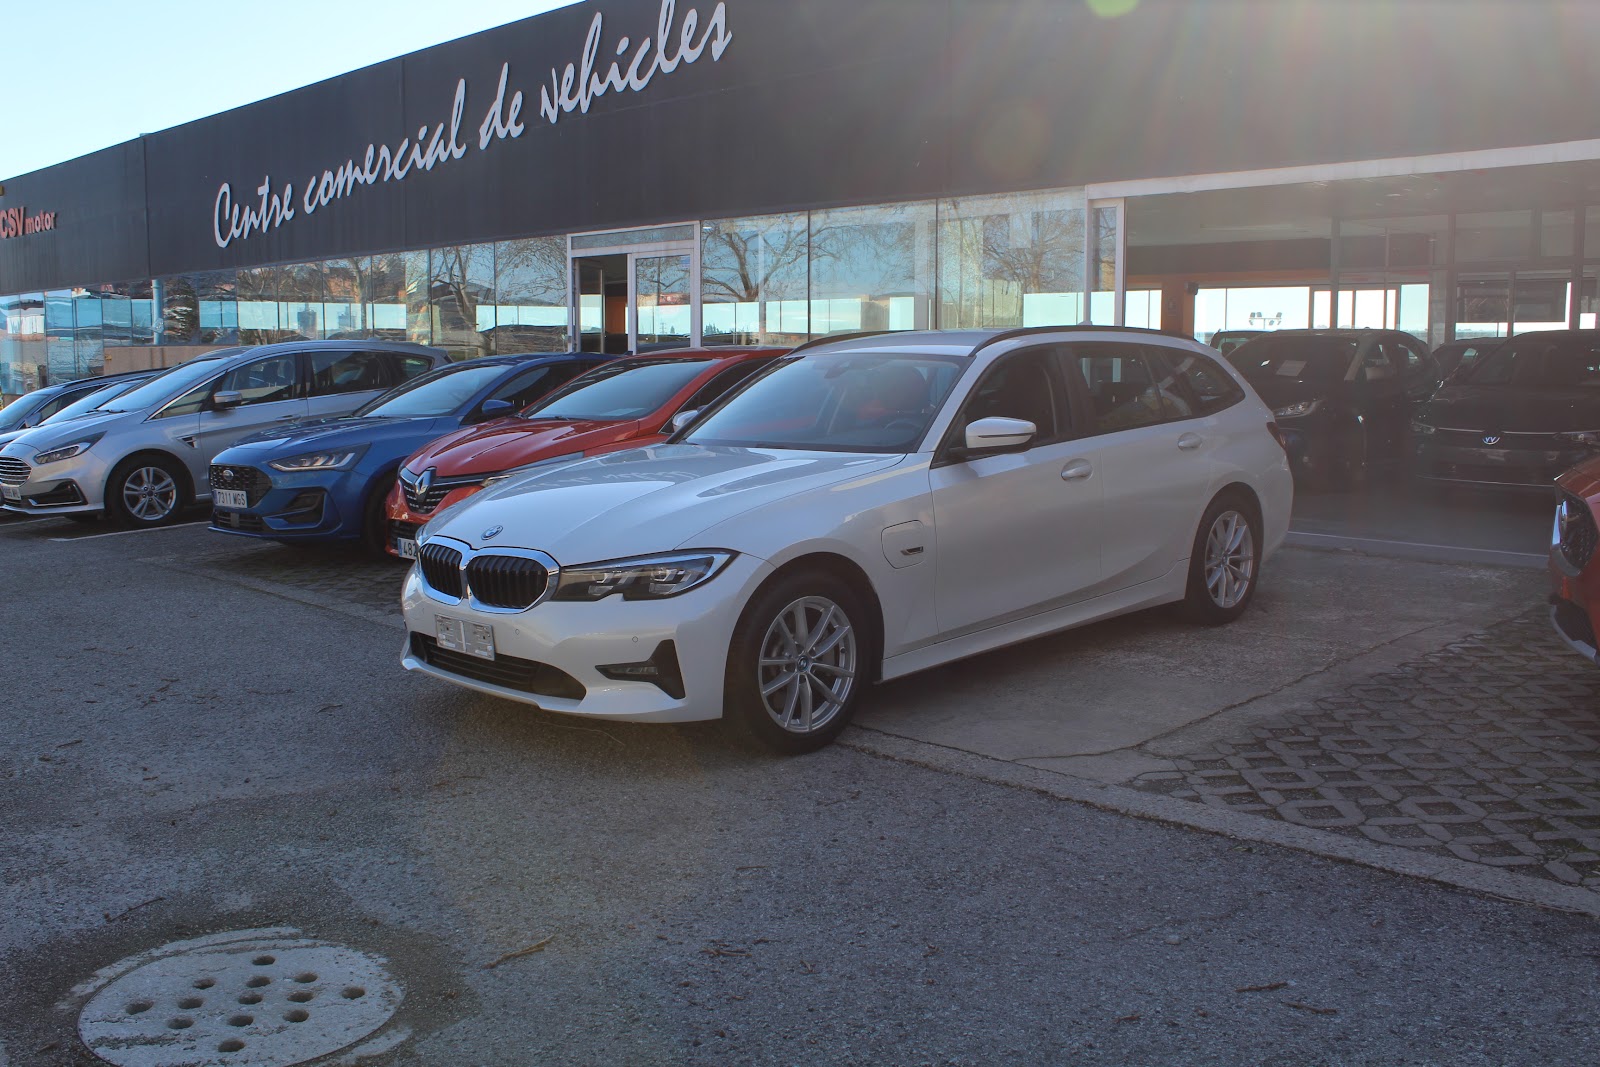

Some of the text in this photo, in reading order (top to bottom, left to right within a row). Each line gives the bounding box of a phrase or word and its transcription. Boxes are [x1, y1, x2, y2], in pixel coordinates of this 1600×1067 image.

[214, 0, 733, 249] Centre comercial de vehicles
[0, 206, 56, 239] CSV motor
